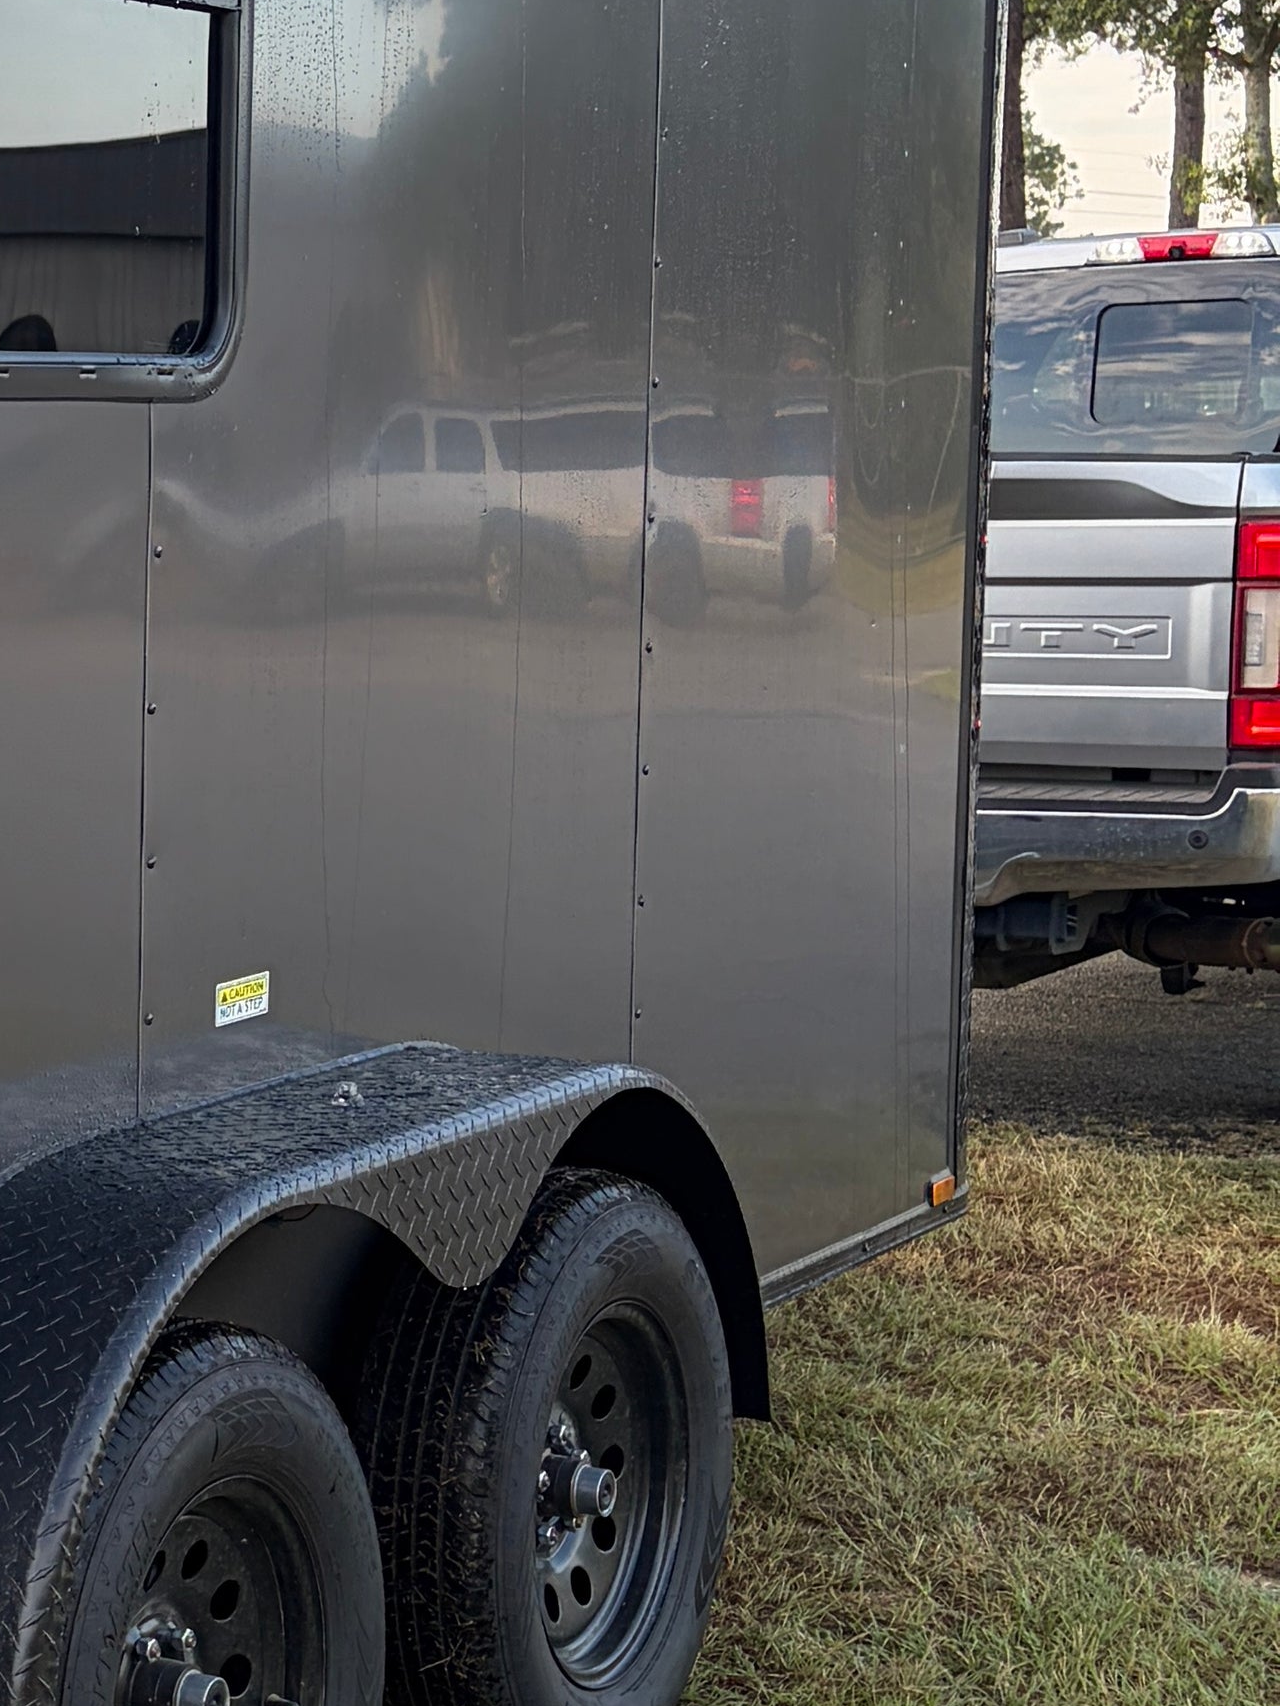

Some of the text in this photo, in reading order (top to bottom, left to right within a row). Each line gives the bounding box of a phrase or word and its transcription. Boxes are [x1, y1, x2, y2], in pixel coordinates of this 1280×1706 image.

[229, 981, 264, 1000] CAUTION
[220, 1003, 236, 1019] NOT
[245, 996, 264, 1013] STEP
